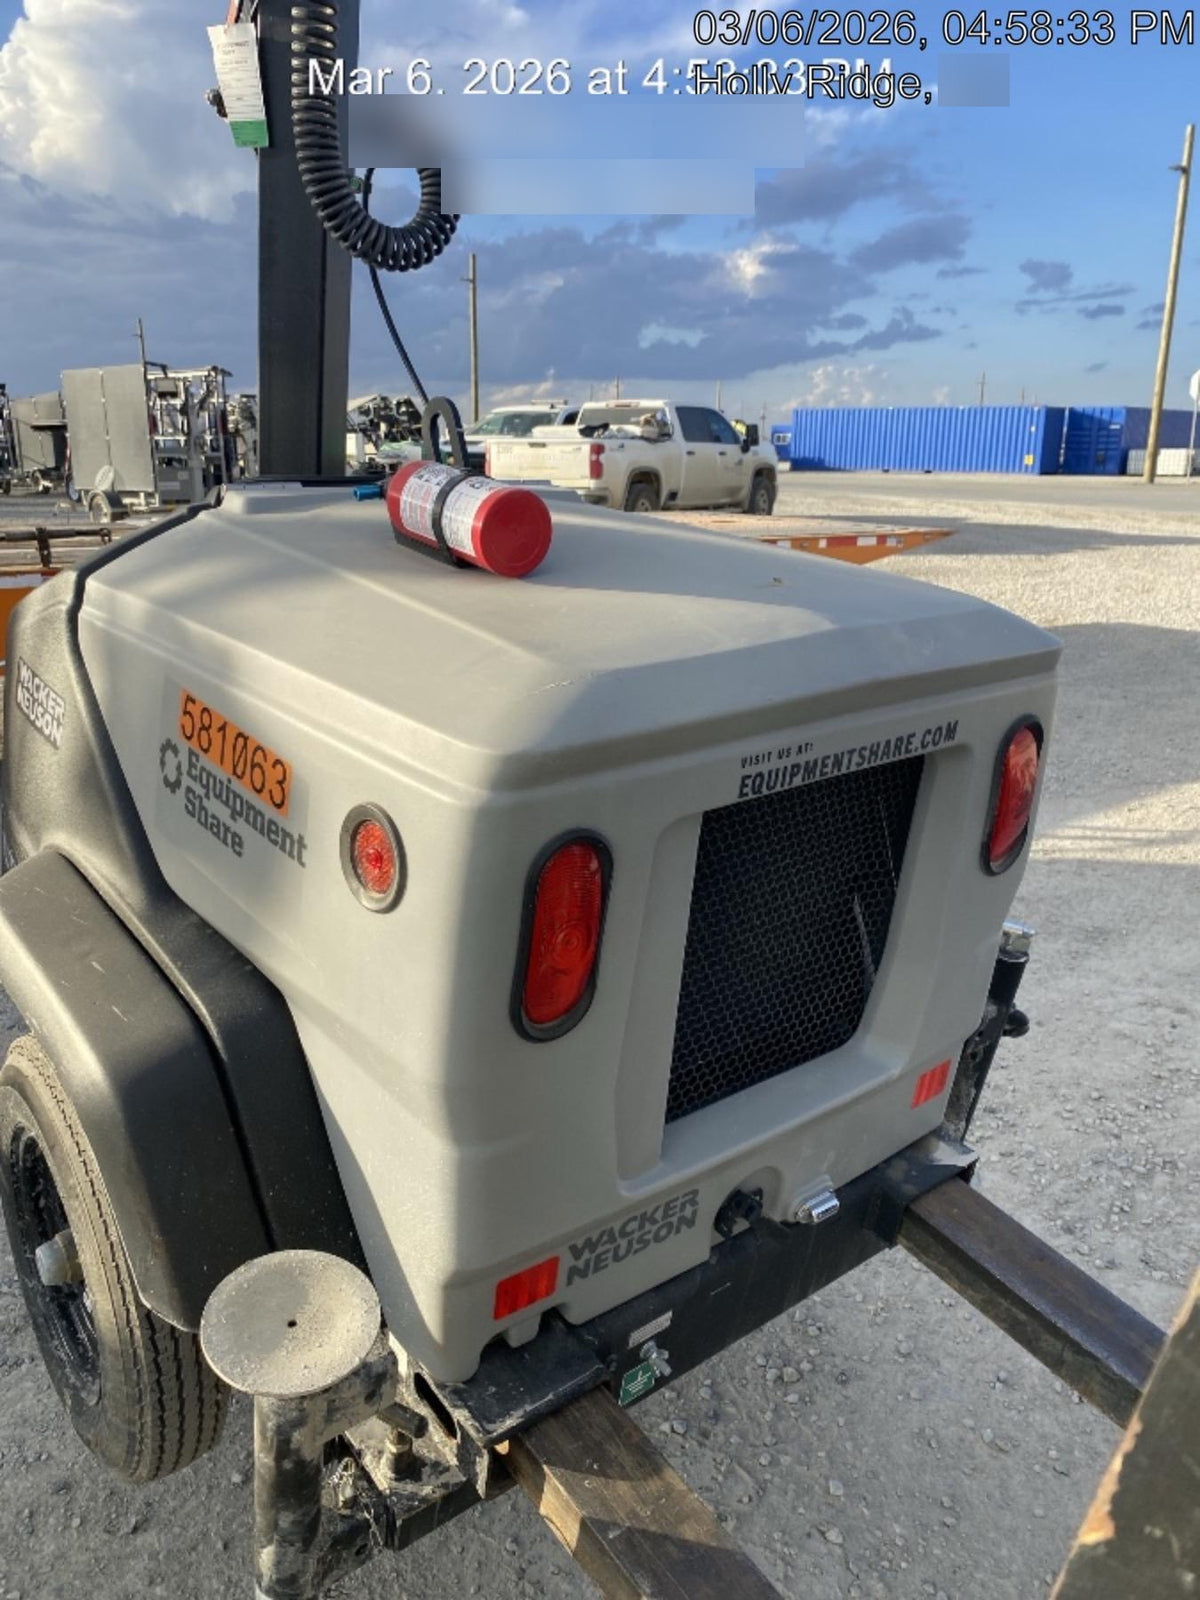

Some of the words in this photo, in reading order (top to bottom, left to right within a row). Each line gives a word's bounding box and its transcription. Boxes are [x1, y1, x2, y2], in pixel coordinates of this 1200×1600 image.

[17, 684, 63, 748] NEUSON
[18, 662, 65, 724] WACKER
[180, 694, 288, 811] 581063
[738, 720, 960, 799] EQUIPMENTSHARE.COM
[741, 751, 773, 769] VISIT
[777, 747, 793, 760] US
[183, 786, 246, 859] Share
[185, 748, 309, 868] Equipment
[566, 1207, 698, 1287] NEUSON
[567, 1188, 700, 1262] WACKER
